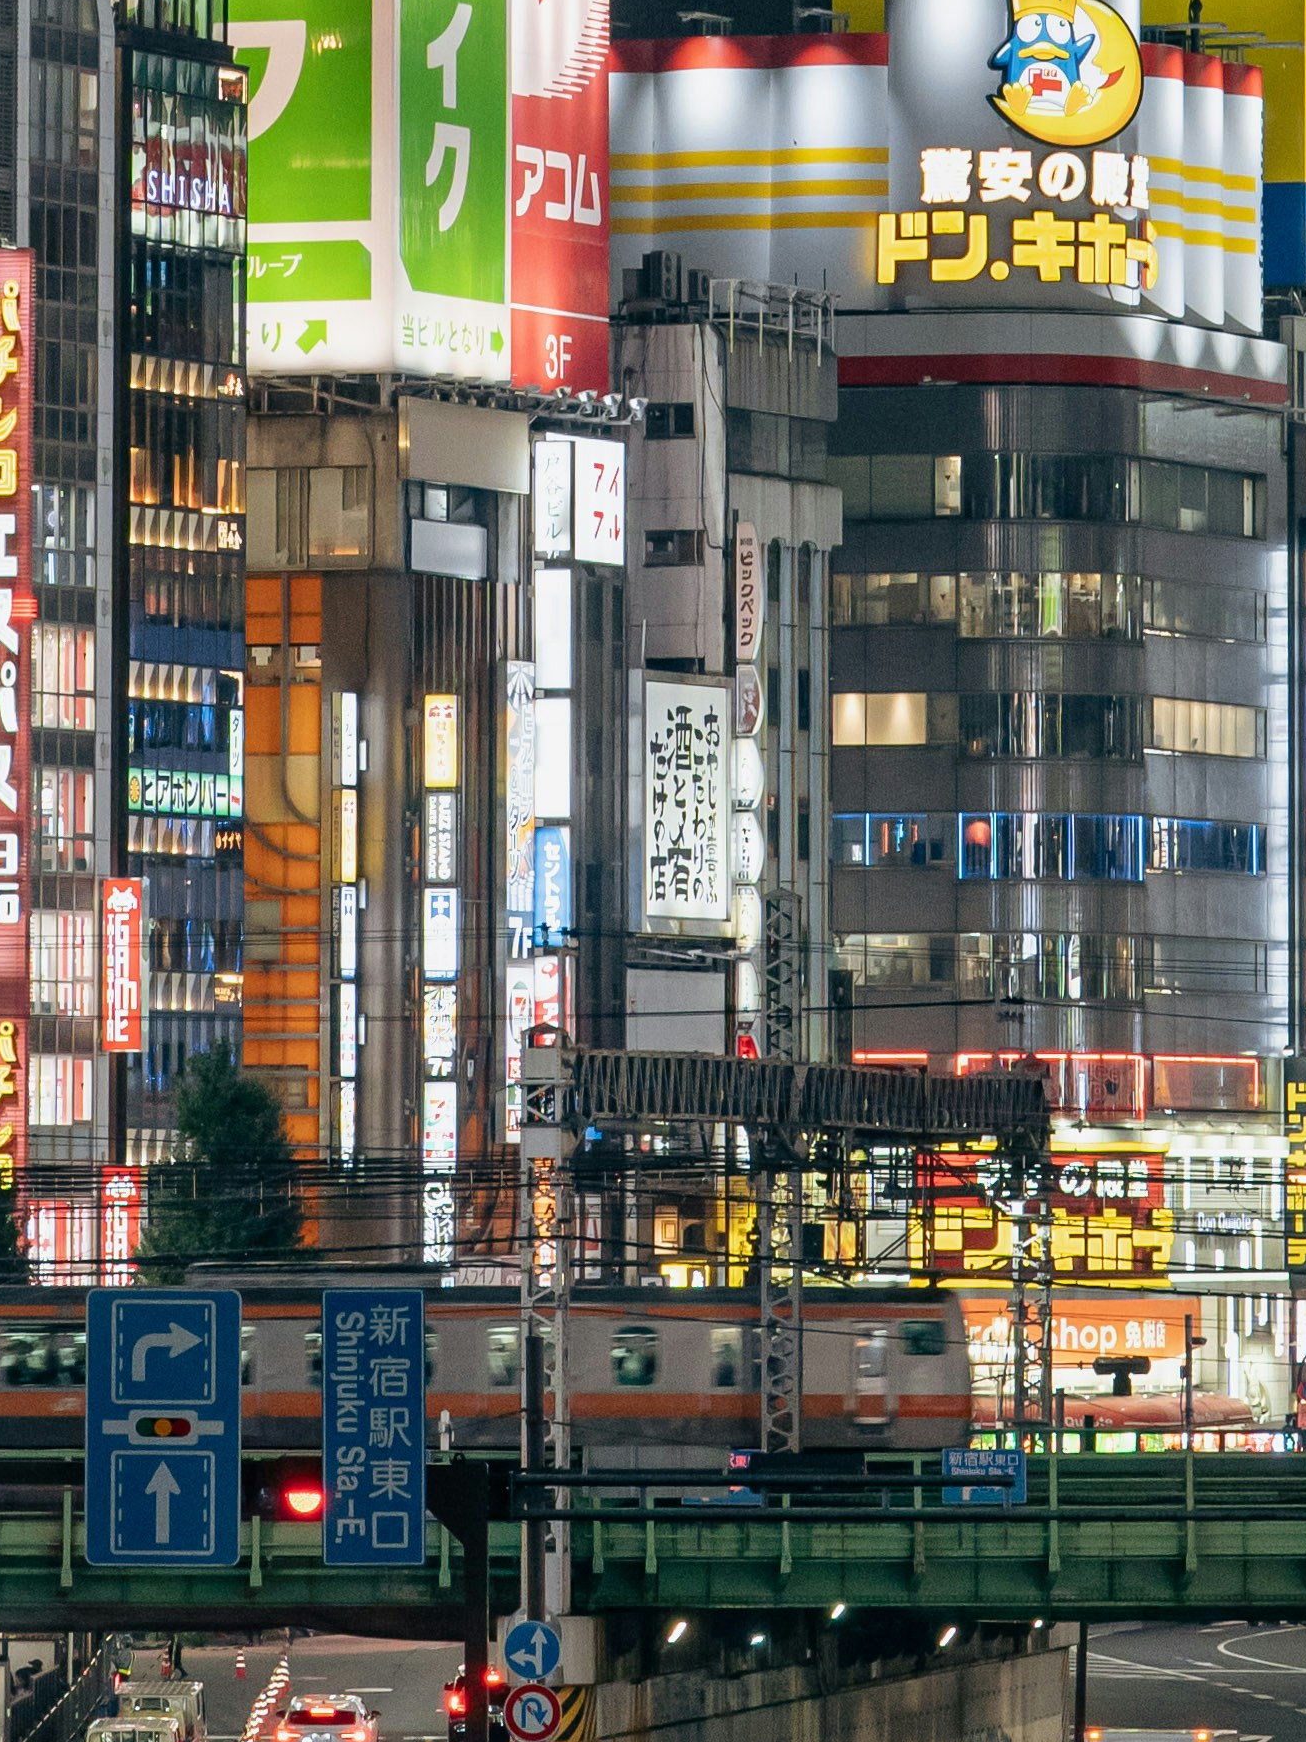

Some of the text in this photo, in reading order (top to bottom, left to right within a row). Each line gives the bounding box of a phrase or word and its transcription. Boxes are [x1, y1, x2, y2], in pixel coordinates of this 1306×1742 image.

[146, 170, 233, 215] SHISHA
[515, 144, 602, 227] アコム
[920, 147, 1149, 209] 驚安の殿堂
[401, 313, 487, 356] 当ビルとなり
[545, 334, 573, 380] 3F
[231, 715, 241, 769] ダーツ
[143, 773, 227, 812] ビアポンバー
[649, 731, 668, 902] だけの店
[509, 916, 533, 959] 7F
[114, 913, 138, 1043] GAME
[428, 1058, 452, 1077] 7F
[1197, 1211, 1215, 1231] Don
[1124, 1320, 1167, 1349] 免税店
[334, 1310, 367, 1434] Shinjuku
[369, 1304, 411, 1550] 新宿駅東口
[948, 1451, 1020, 1467] 新宿駅東口
